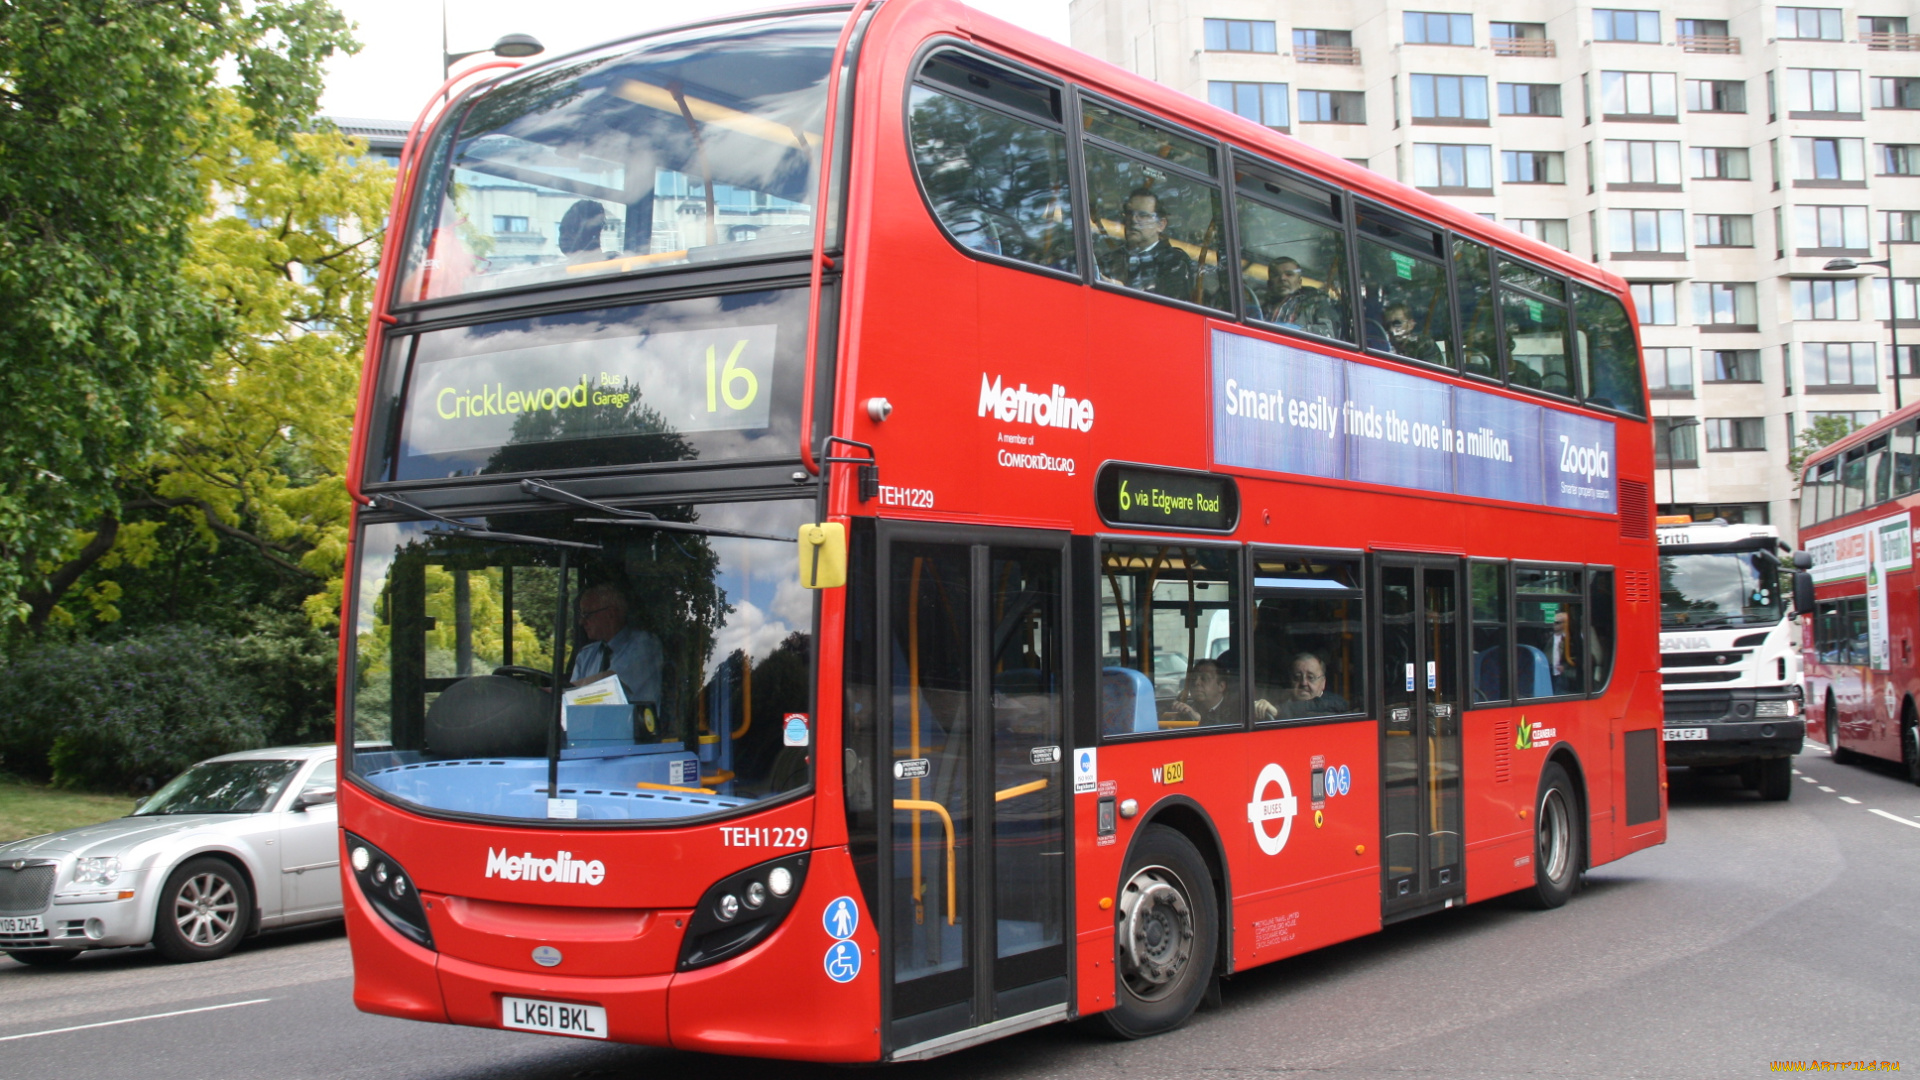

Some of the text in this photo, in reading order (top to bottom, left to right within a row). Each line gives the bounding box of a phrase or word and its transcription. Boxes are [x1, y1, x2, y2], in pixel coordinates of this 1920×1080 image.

[601, 371, 620, 386] Bus
[705, 340, 758, 413] 16
[437, 374, 588, 420] Cricklewood
[592, 391, 629, 408] Garage
[978, 371, 1094, 433] Metroline
[1226, 378, 1513, 463] Smart easily finds the one in a million.
[1003, 434, 1027, 445] member
[1560, 434, 1609, 484] Zoopla
[878, 485, 934, 509] TEH1229
[1120, 480, 1219, 515] 6 via Edgware Road
[1151, 762, 1182, 784] W 620
[1263, 803, 1282, 816] BUSES
[719, 827, 808, 848] TEH1229
[485, 847, 605, 886] Metroline
[17, 917, 39, 931] ZHZ
[513, 1001, 595, 1033] LK61 BKL
